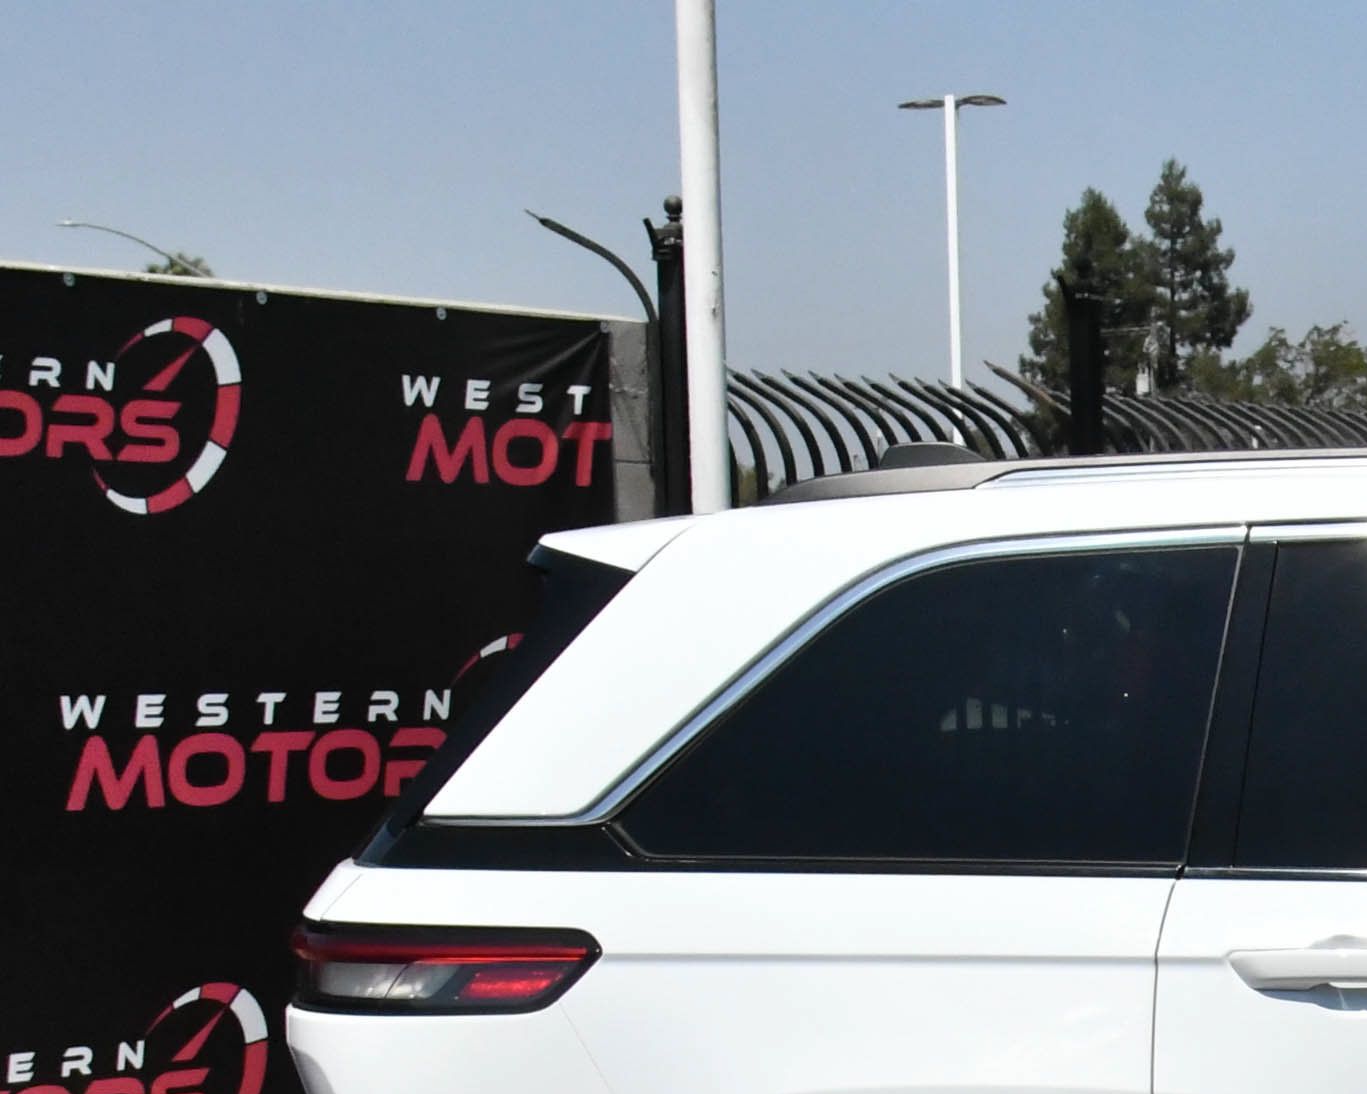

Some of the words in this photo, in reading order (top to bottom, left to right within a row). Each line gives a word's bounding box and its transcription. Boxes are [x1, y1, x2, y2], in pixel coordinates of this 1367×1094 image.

[402, 375, 592, 416] WEST
[406, 412, 613, 488] MOT
[60, 689, 452, 731] WESTERN
[7, 1039, 146, 1084] ERN
